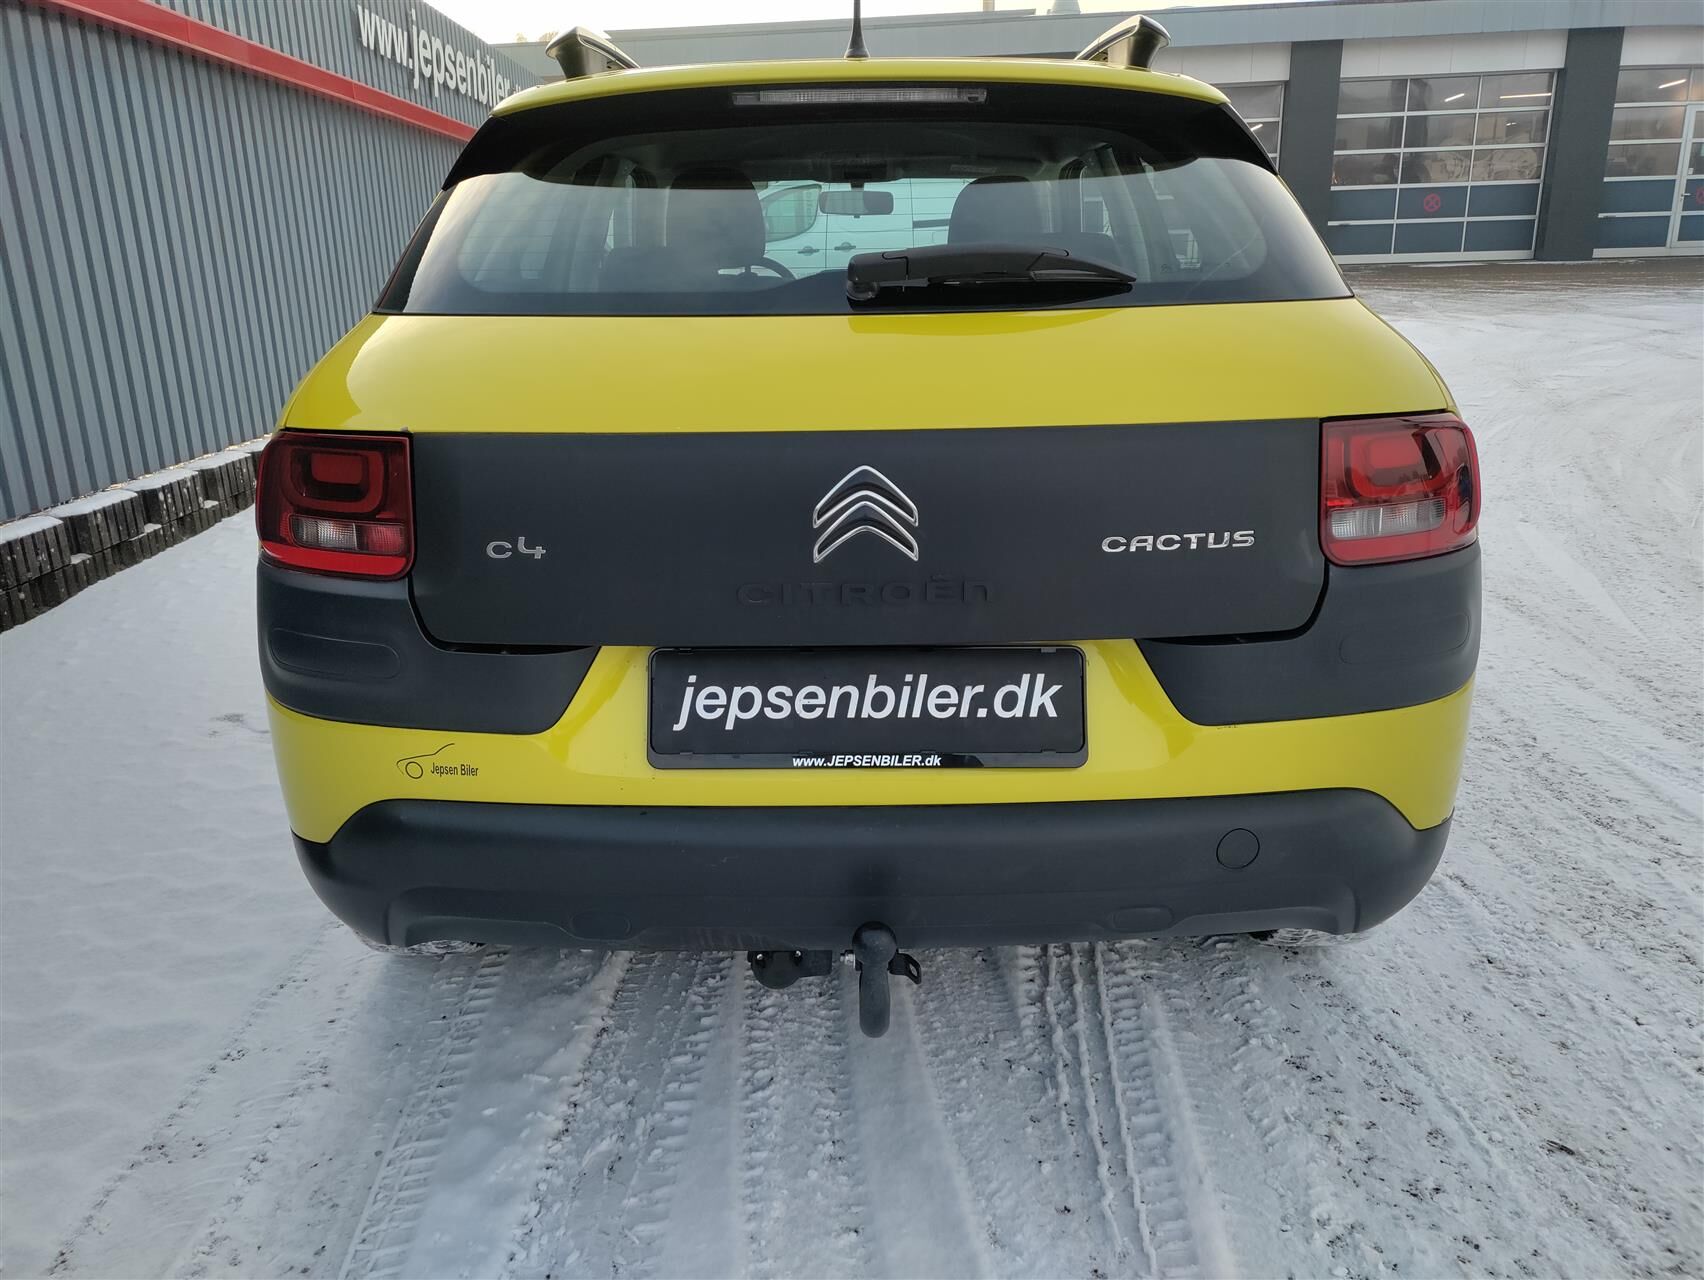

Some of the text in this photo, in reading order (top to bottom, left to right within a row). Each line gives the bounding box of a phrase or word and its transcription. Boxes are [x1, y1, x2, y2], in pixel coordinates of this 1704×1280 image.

[357, 4, 521, 107] www.jepsenbiler
[1101, 530, 1255, 553] CACTUS
[672, 673, 1063, 731] jepsenbiler.dk
[431, 762, 478, 777] Jepsen Biler
[792, 755, 942, 767] www.JEPSENBILER.dk
